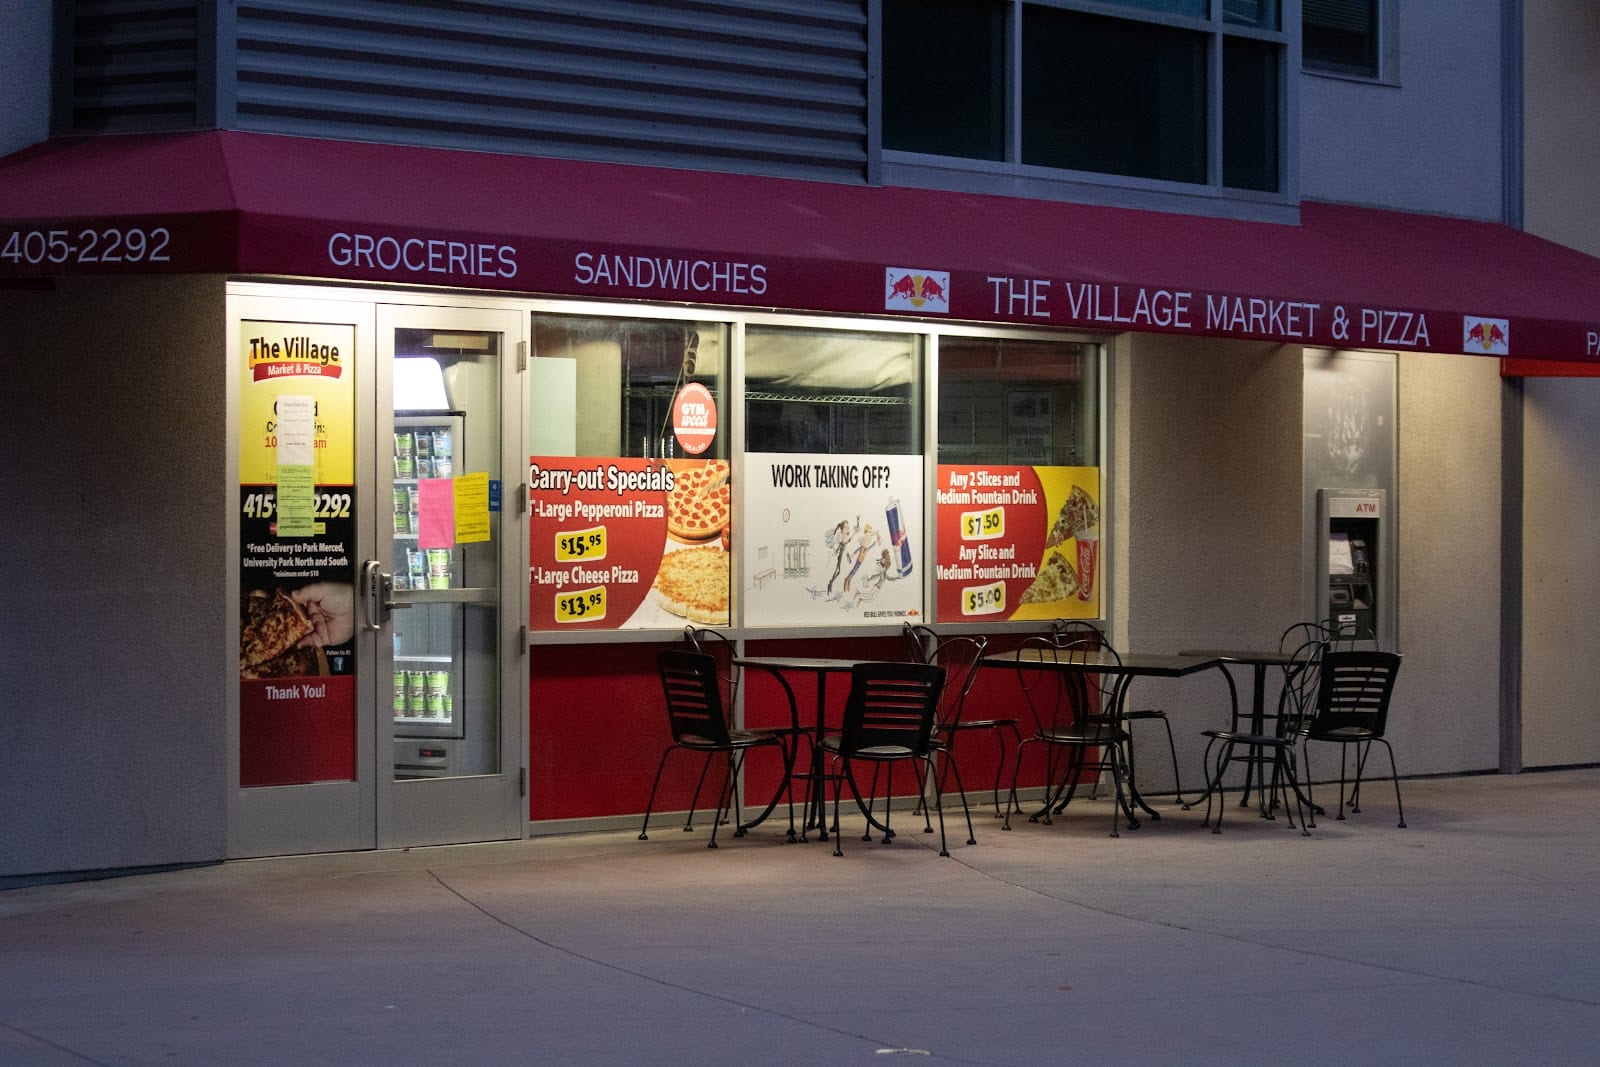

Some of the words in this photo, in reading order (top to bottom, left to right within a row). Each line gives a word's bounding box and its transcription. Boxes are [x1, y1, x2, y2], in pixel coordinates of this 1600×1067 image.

[1, 228, 171, 264] 405-2292
[328, 232, 518, 279] GROCERIES
[574, 252, 768, 295] SANDWICHES
[987, 276, 1052, 318] THE
[1065, 282, 1192, 328] VILLAGE
[1206, 294, 1321, 339] MARKET
[1331, 305, 1350, 340] &
[1361, 309, 1431, 347] PIZZA
[250, 336, 280, 360] The
[284, 336, 340, 366] Village
[1587, 332, 1600, 356] P
[268, 366, 294, 376] Market
[296, 364, 302, 373] &
[304, 364, 322, 374] Pizza
[681, 402, 706, 416] GYM
[684, 442, 706, 452] DEALER
[530, 464, 605, 495] Carry-out
[607, 464, 675, 496] Specials
[772, 464, 811, 488] WORK
[814, 465, 858, 488] TAKING
[862, 466, 890, 488] OFF?
[950, 472, 968, 488] Any
[970, 472, 975, 486] 2
[977, 471, 1002, 487] Slices
[1003, 471, 1020, 486] and
[972, 489, 1010, 504] Fountain
[1012, 488, 1038, 504] Drink
[574, 500, 633, 522] Pepperoni
[635, 500, 664, 518] Pizza
[1356, 503, 1376, 513] ATM
[266, 544, 294, 554] Delivery
[303, 543, 318, 552] Park
[561, 534, 602, 556] $15.95
[960, 545, 976, 563] Any
[978, 544, 998, 560] Slice
[998, 544, 1015, 560] and
[244, 558, 278, 568] University
[278, 558, 294, 566] Park
[294, 557, 314, 566] North
[315, 556, 328, 566] and
[328, 556, 348, 566] South
[973, 564, 1010, 580] Fountain
[1012, 562, 1036, 578] Drink
[571, 566, 610, 584] Cheese
[612, 565, 638, 584] Pizza
[561, 593, 602, 616] $13.95
[266, 684, 300, 700] Thank
[302, 684, 326, 698] You!
